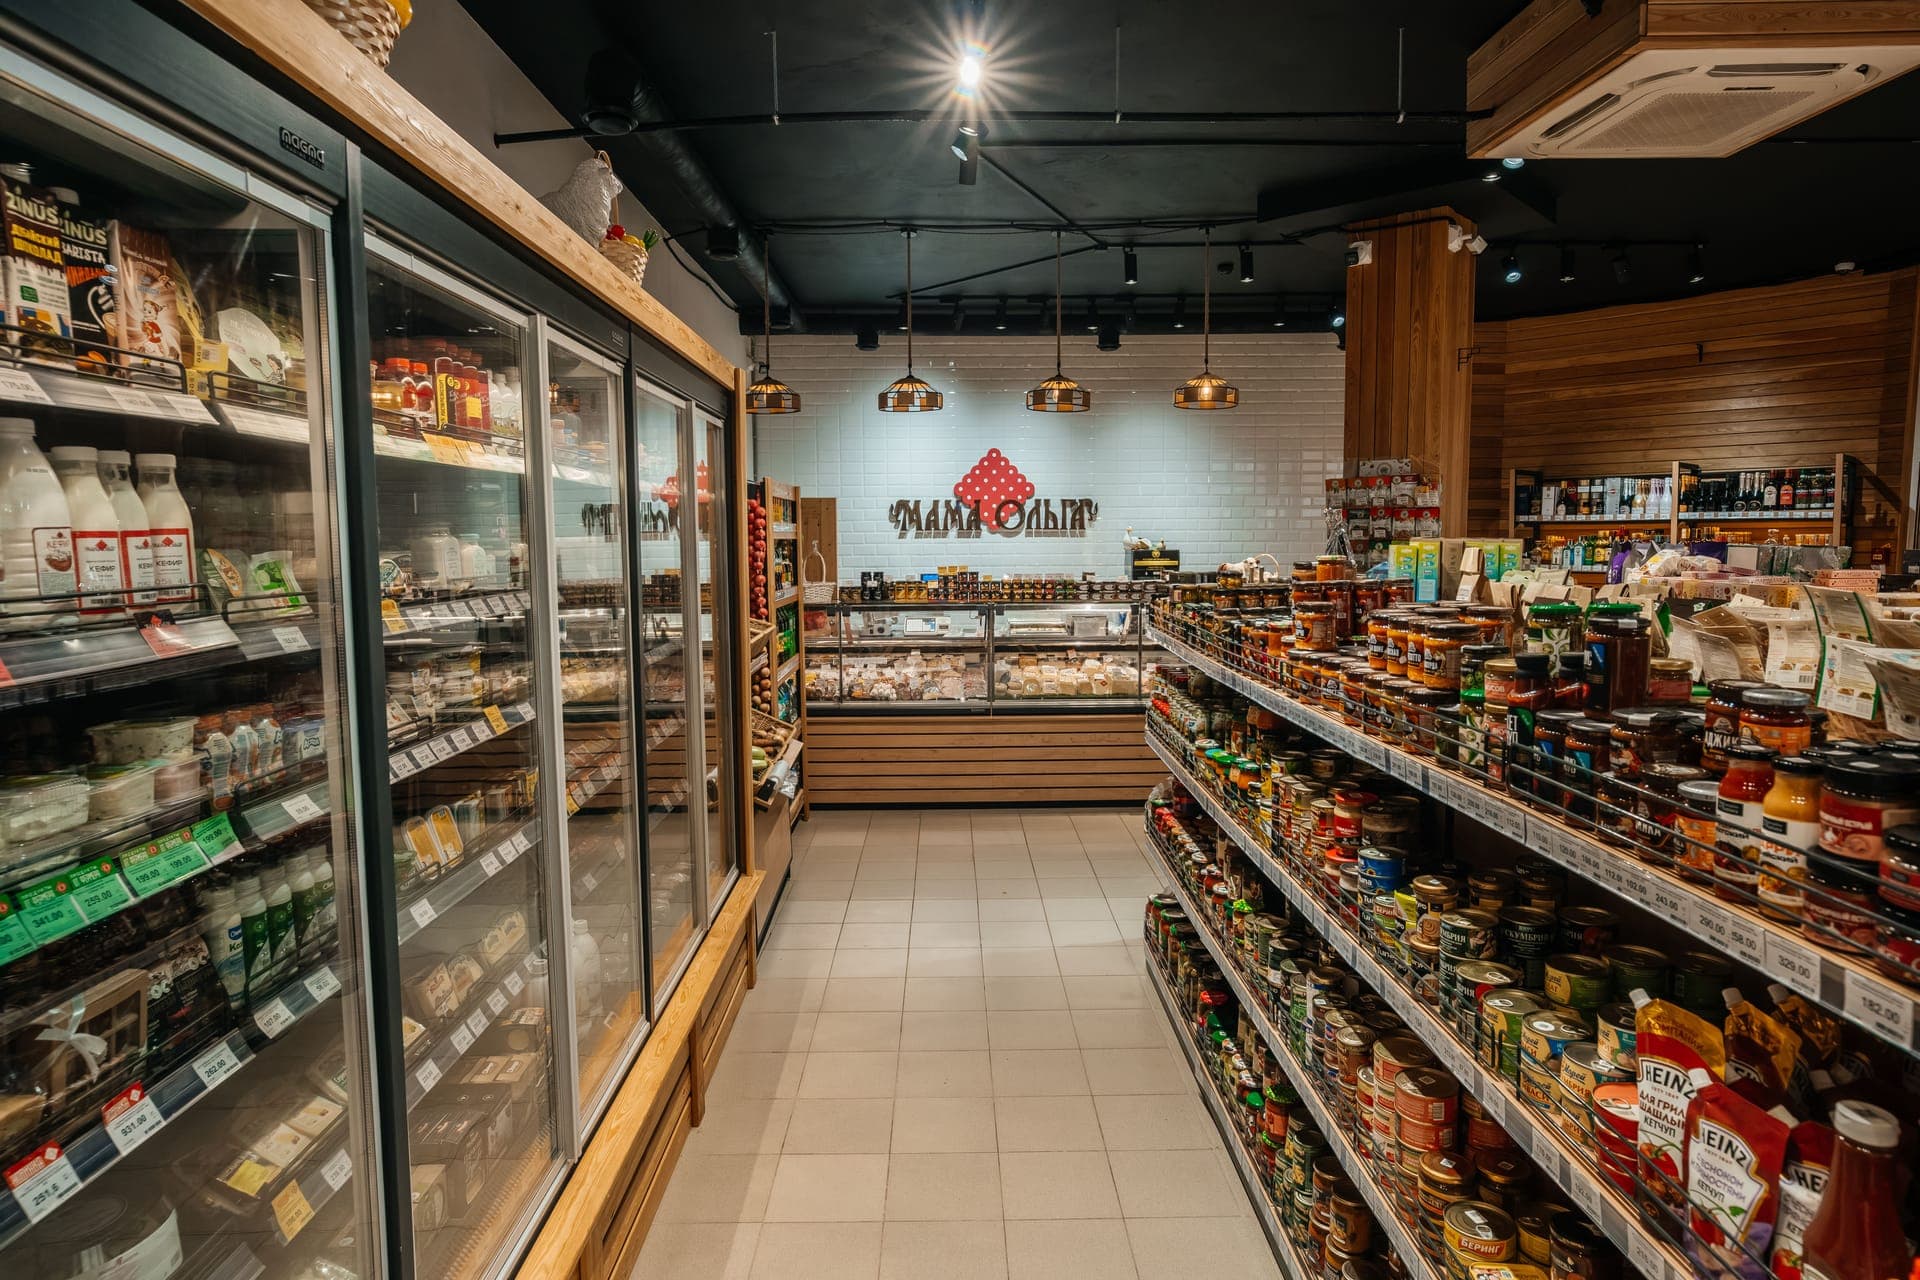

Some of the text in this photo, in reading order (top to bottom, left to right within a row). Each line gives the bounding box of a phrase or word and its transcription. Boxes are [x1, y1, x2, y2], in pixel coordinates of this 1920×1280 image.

[60, 217, 107, 245] INUS
[889, 498, 1098, 531] МАМА ОЛЬГА
[89, 565, 116, 573] КЕФИР
[136, 869, 160, 884] 199.00
[1626, 879, 1647, 895] 102.00
[1655, 893, 1679, 911] 243.00
[1700, 914, 1726, 936] 290.00
[1778, 954, 1810, 980] 329.00
[1861, 996, 1900, 1025] 182.00
[204, 1059, 226, 1078] 262.00
[1645, 1064, 1697, 1099] HEINZ
[1657, 1098, 1686, 1120] ГРИЛ
[121, 1114, 147, 1136] 931.00
[1643, 1115, 1676, 1138] КЕТЧУП
[1461, 1238, 1500, 1255] БЕРИНГ
